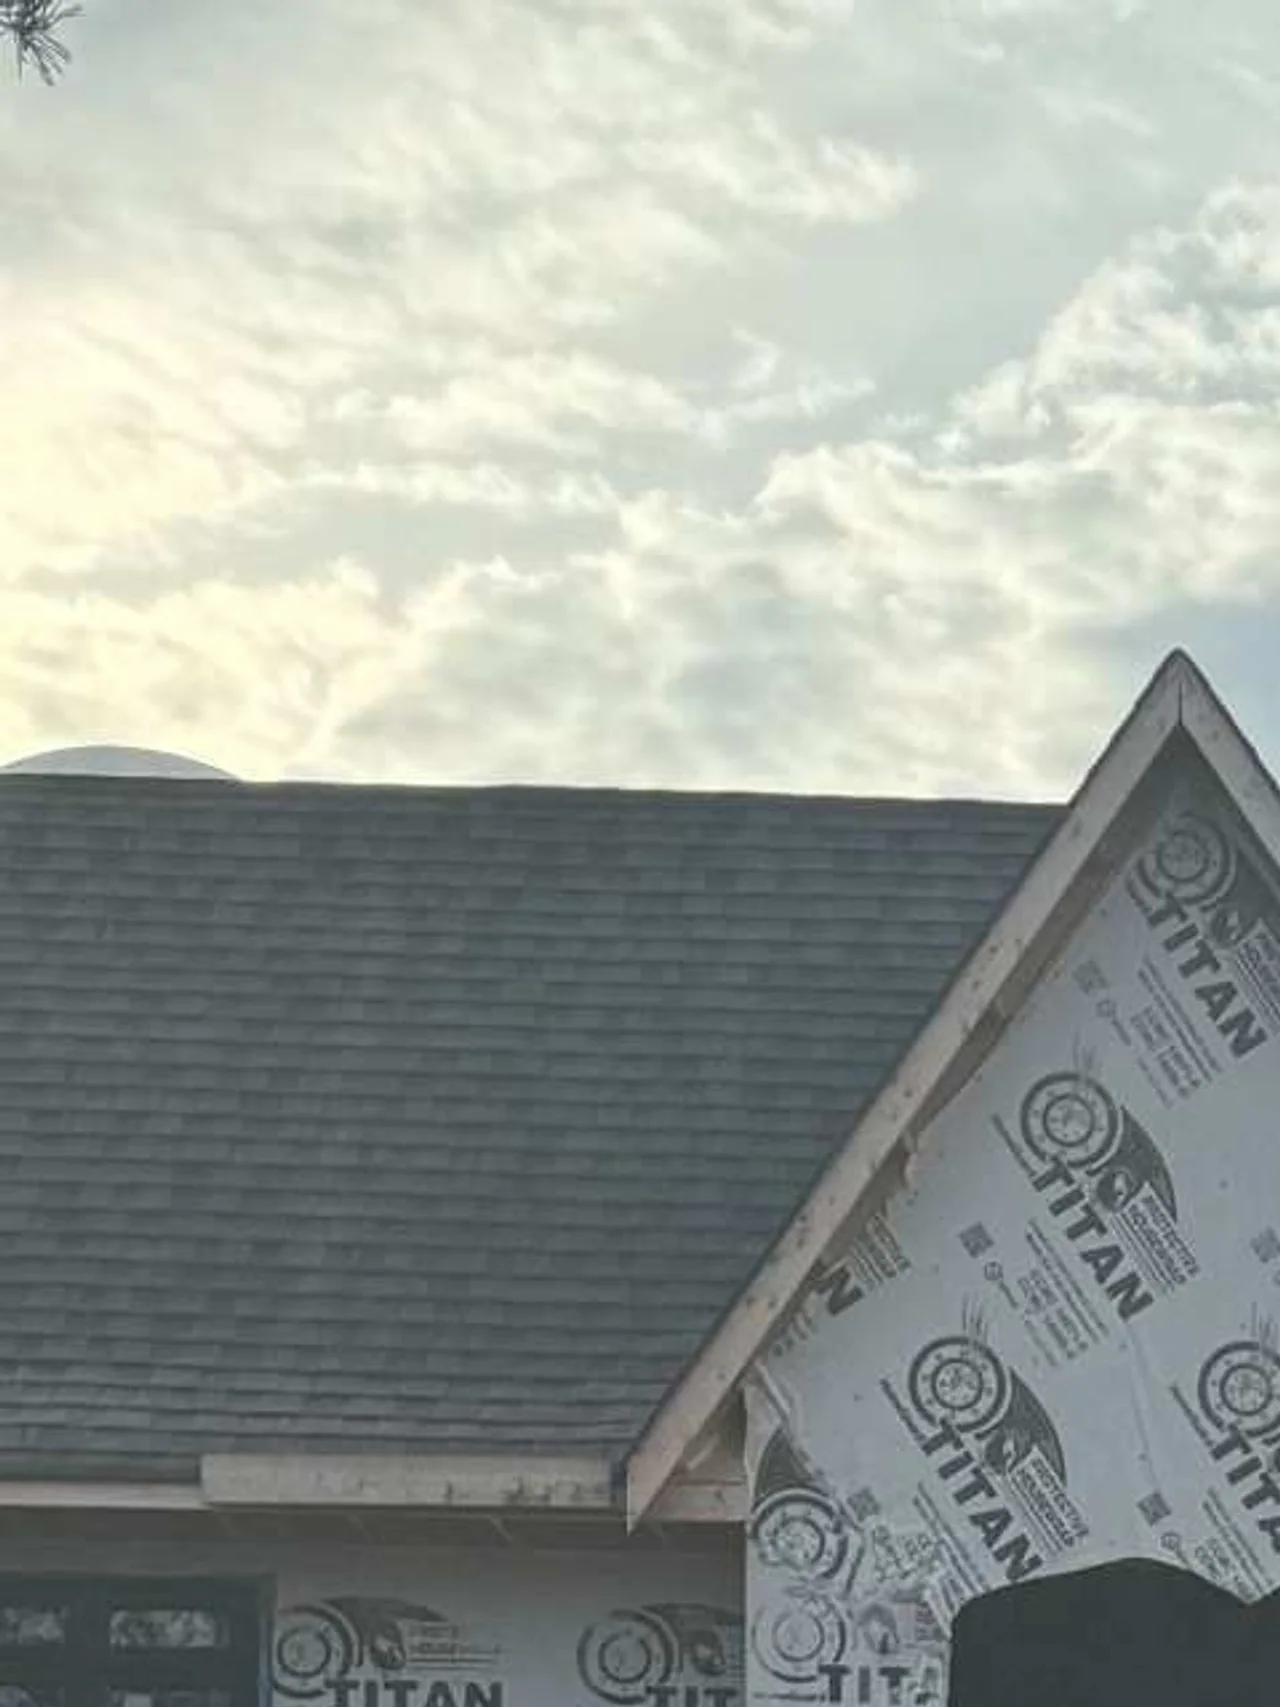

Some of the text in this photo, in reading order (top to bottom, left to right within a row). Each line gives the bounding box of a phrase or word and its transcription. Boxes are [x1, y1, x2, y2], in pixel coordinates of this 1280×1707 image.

[1145, 893, 1268, 1060] TITAN
[1031, 1155, 1155, 1321] TITAN
[920, 1417, 1046, 1582] TITAN
